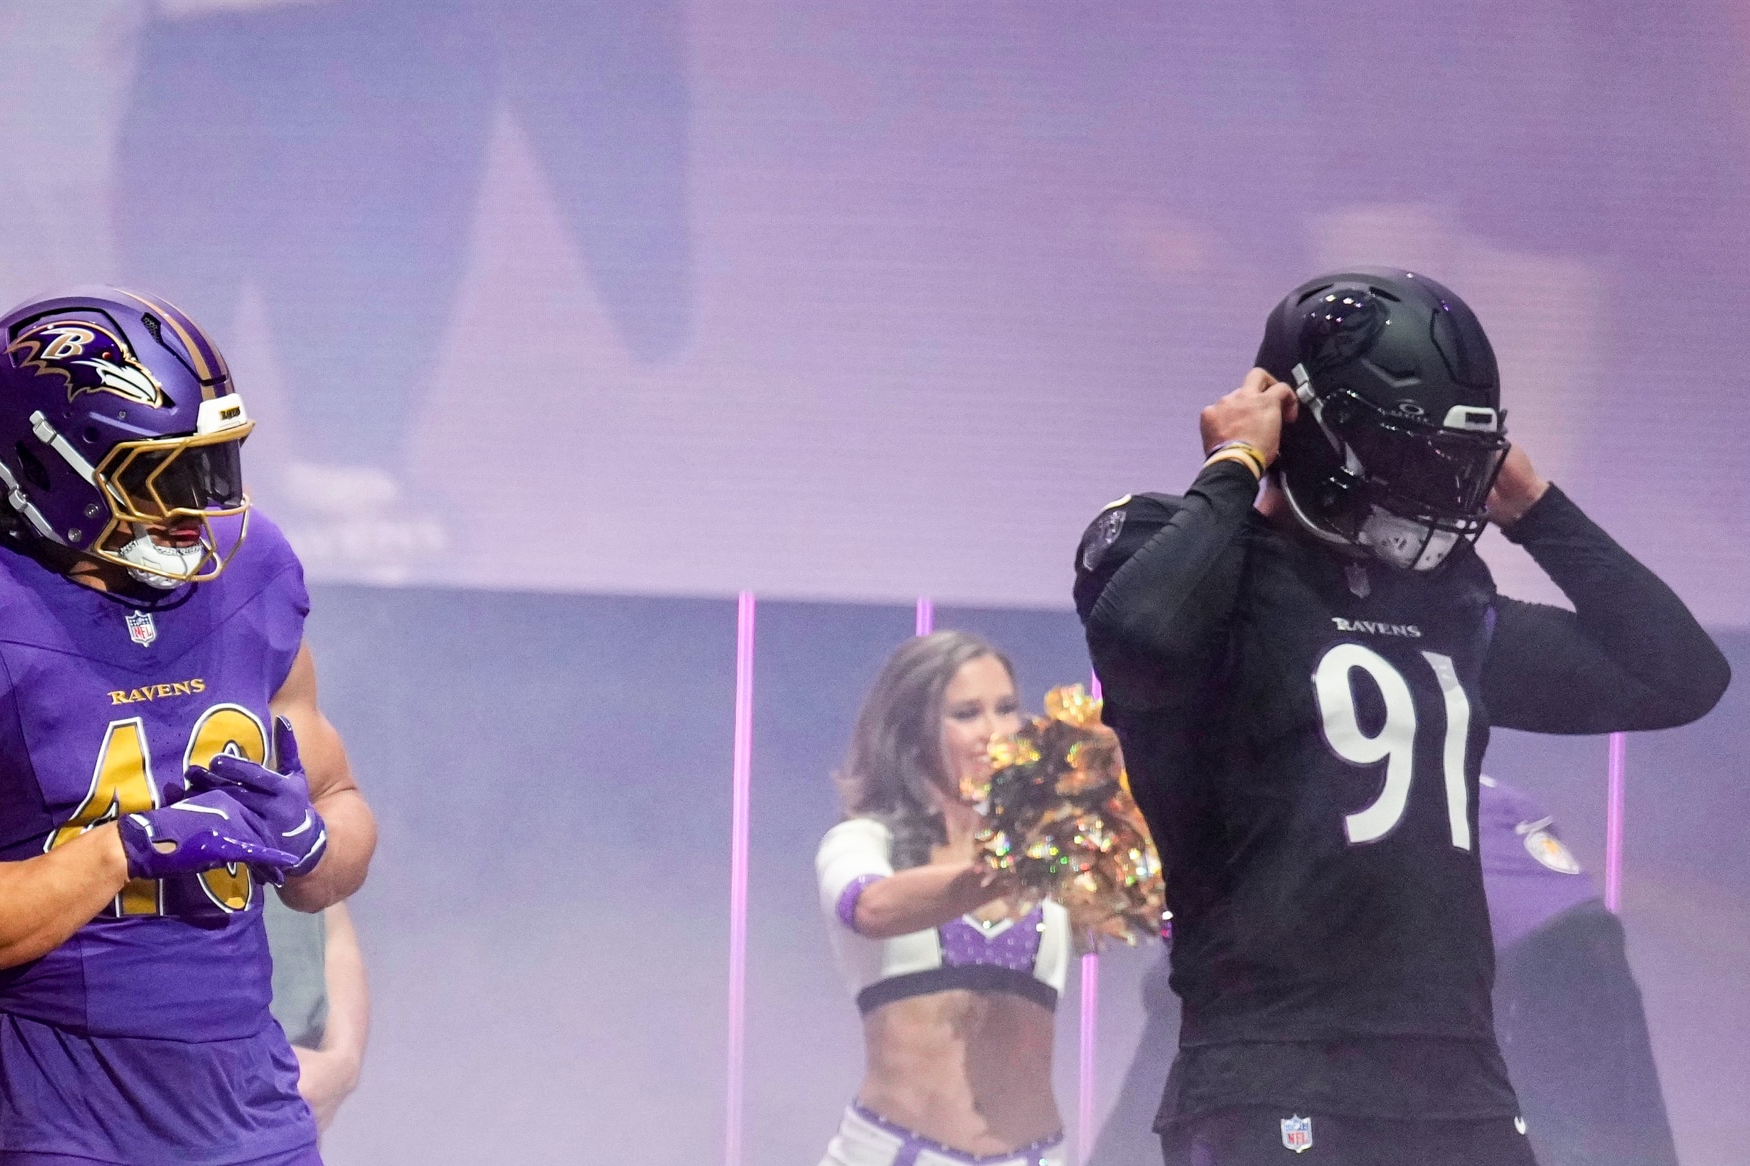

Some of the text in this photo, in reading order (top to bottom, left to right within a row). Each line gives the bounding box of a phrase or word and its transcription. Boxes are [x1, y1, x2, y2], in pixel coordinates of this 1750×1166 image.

[40, 327, 95, 360] B
[134, 625, 153, 639] NFL
[1331, 616, 1422, 638] RAVENS
[107, 678, 206, 705] RAVENS
[1311, 642, 1471, 851] 91
